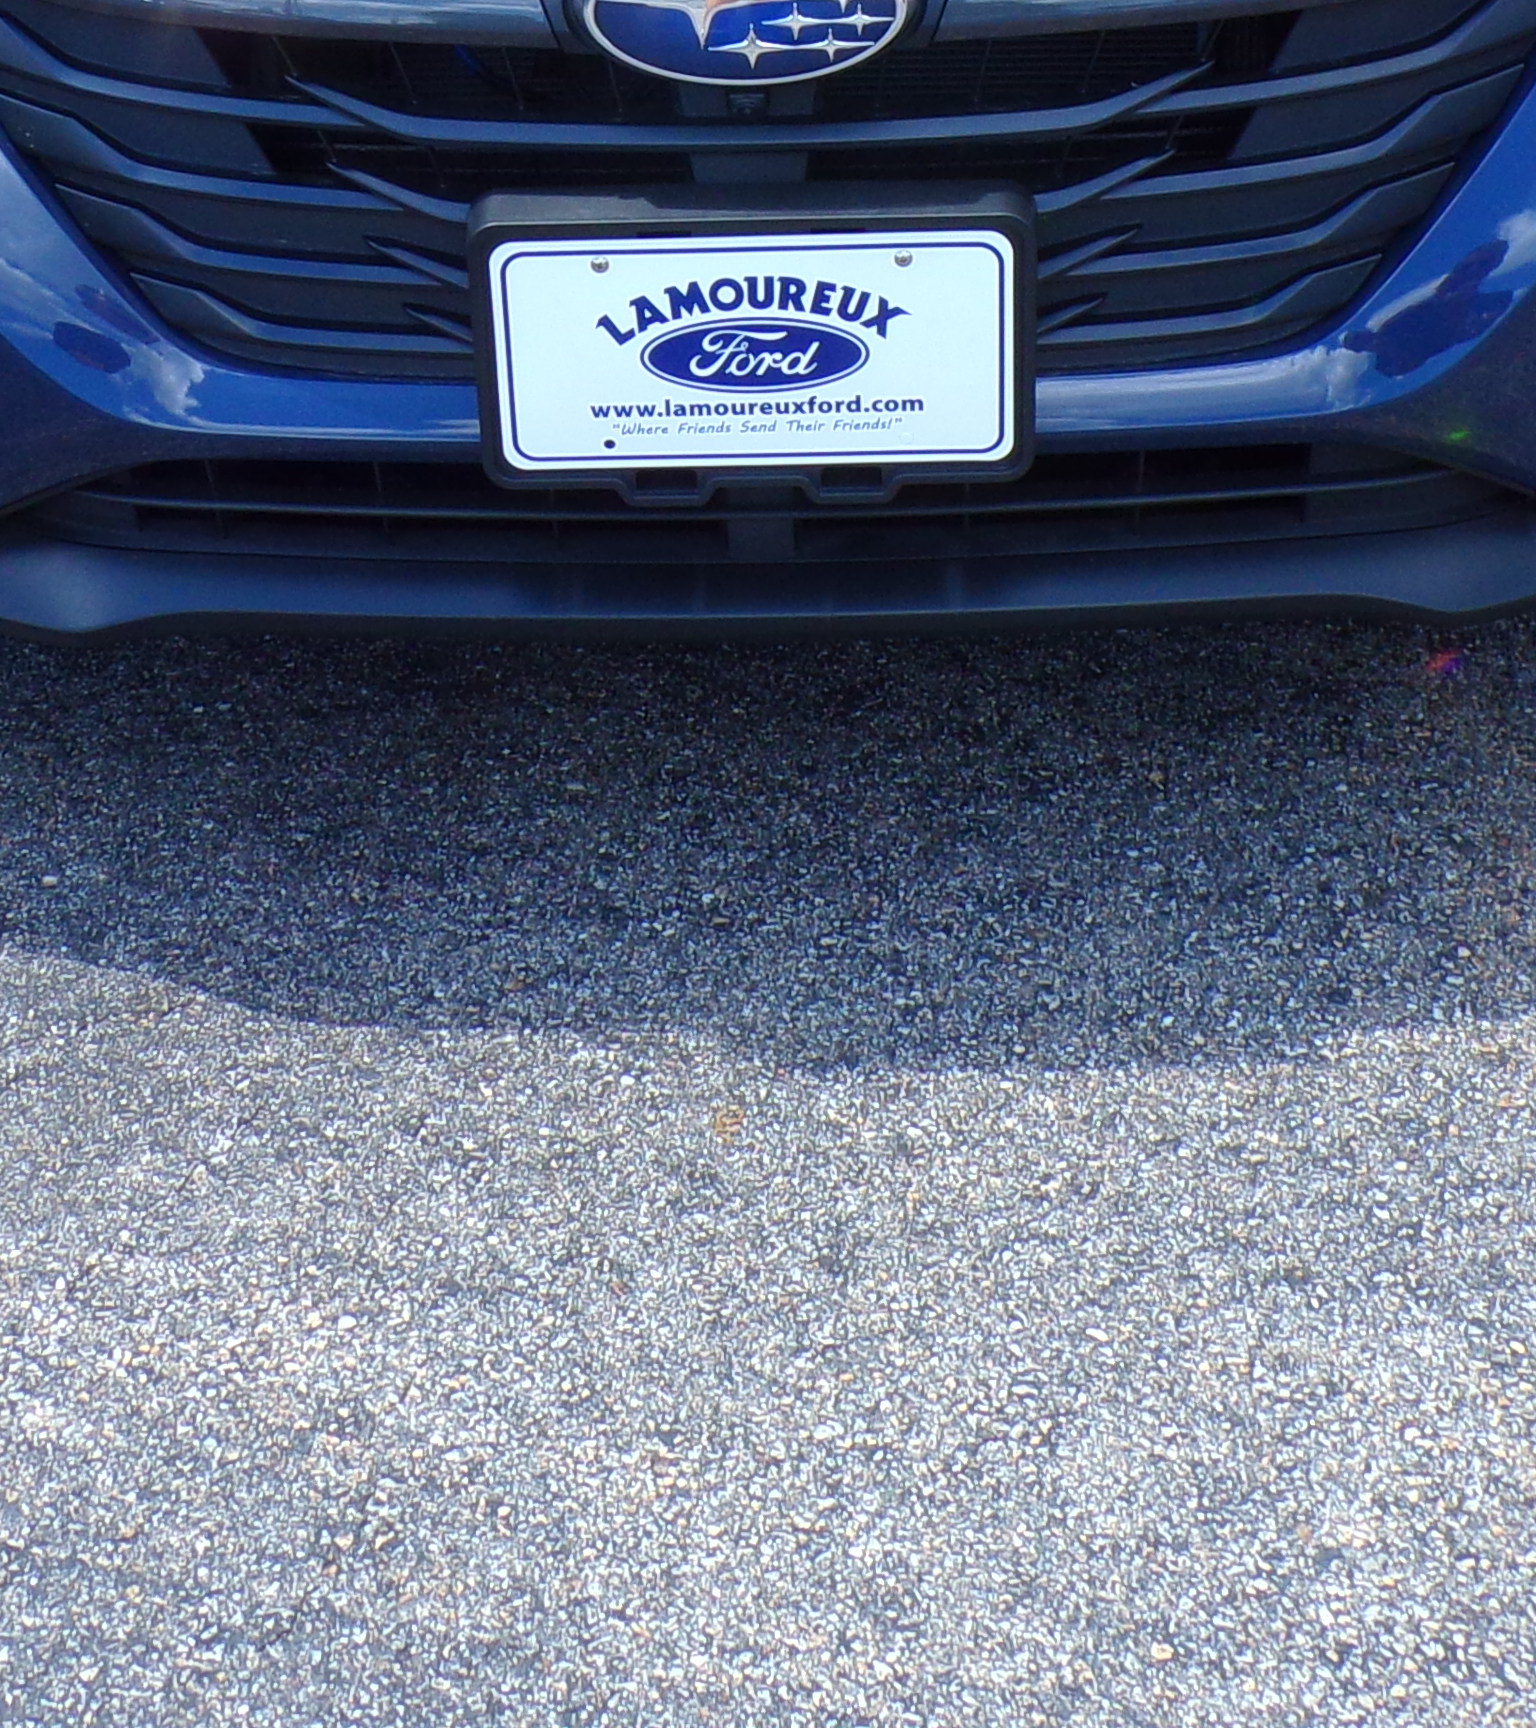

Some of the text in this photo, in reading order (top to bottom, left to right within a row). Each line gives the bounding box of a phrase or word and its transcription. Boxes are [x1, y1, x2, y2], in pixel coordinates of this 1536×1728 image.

[595, 275, 913, 346] LAMOUREUX
[689, 329, 820, 377] Ford
[590, 395, 925, 419] www.lamoureuxford.com
[677, 421, 731, 435] Friends
[740, 420, 776, 434] Send
[786, 419, 826, 432] Their
